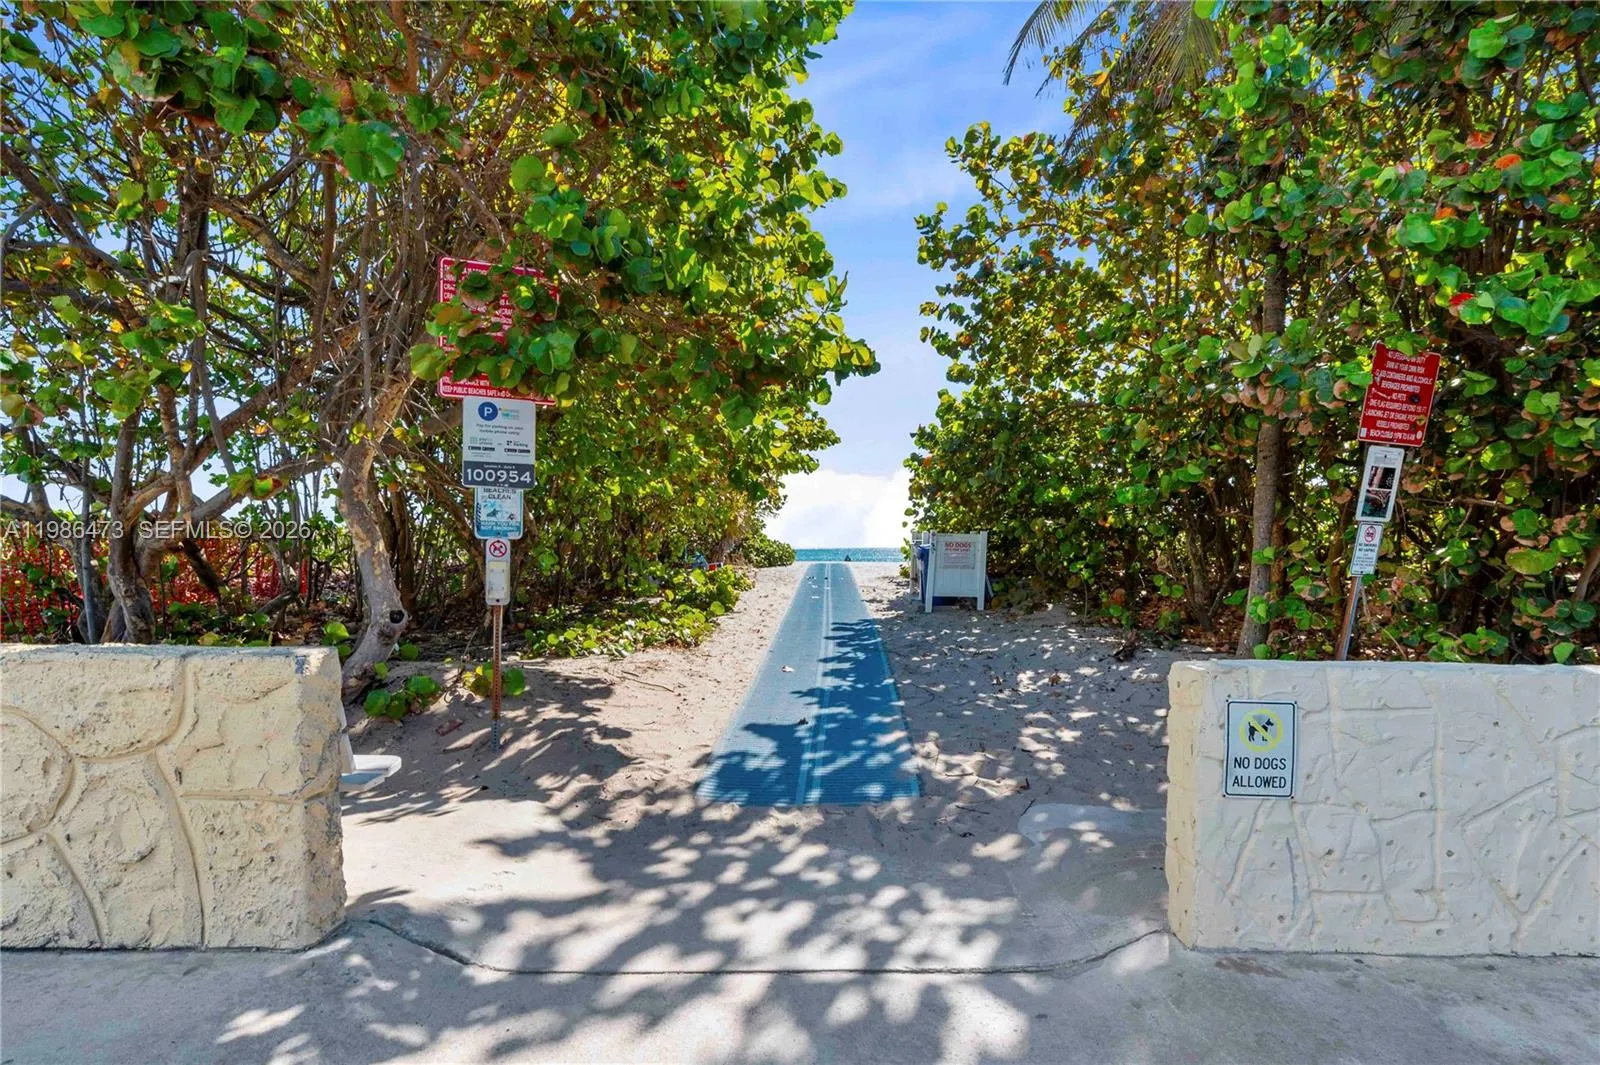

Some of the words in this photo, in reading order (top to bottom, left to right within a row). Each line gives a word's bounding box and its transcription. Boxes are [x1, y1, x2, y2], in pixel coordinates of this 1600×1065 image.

[453, 386, 468, 394] PUBLIC
[468, 387, 486, 395] BEACHES
[484, 407, 492, 416] P
[466, 468, 532, 484] 100954
[1234, 756, 1250, 769] NO
[1254, 757, 1286, 770] DOGS
[1232, 776, 1286, 788] ALLOWED
